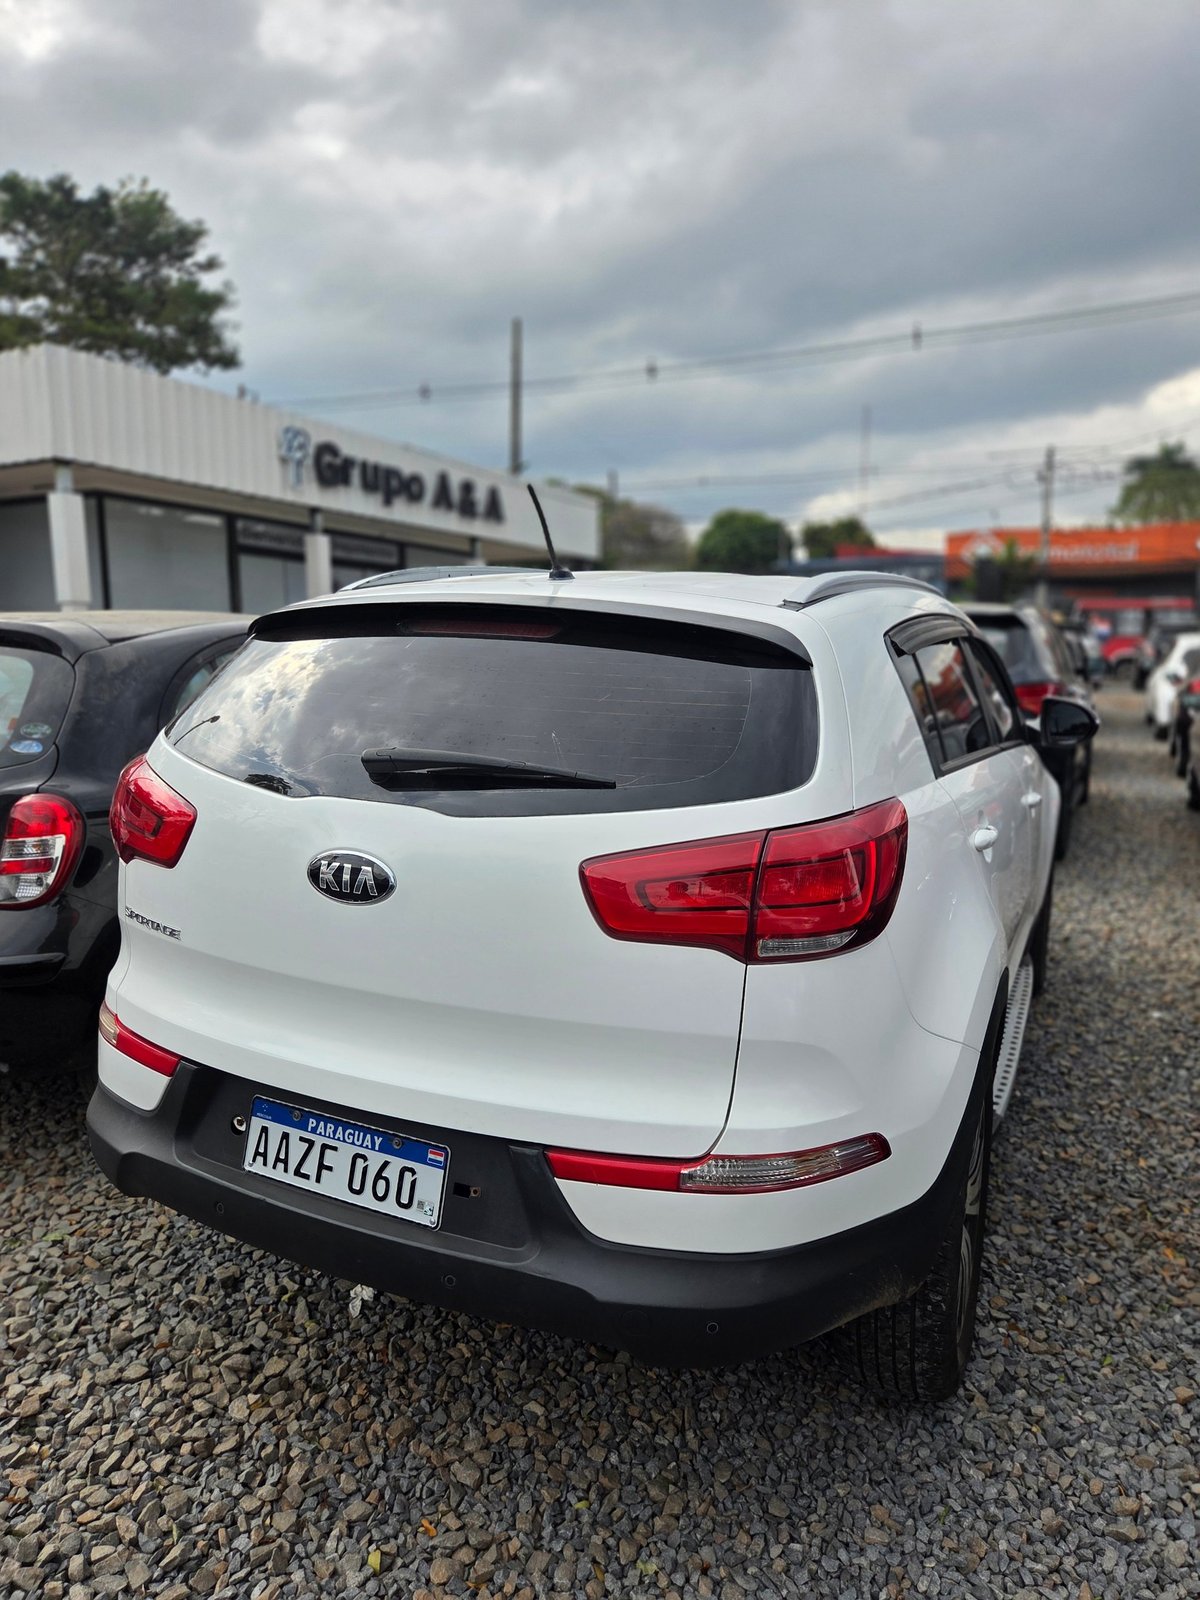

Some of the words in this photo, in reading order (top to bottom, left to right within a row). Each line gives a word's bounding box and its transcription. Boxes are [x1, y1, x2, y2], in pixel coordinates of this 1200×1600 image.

[313, 441, 426, 505] Grupo
[432, 469, 505, 525] A&A
[319, 860, 378, 896] KIA
[125, 906, 182, 941] SPORTAGE
[307, 1117, 383, 1151] PARAGUAY
[251, 1125, 339, 1184] AAZF
[347, 1152, 418, 1210] 060
